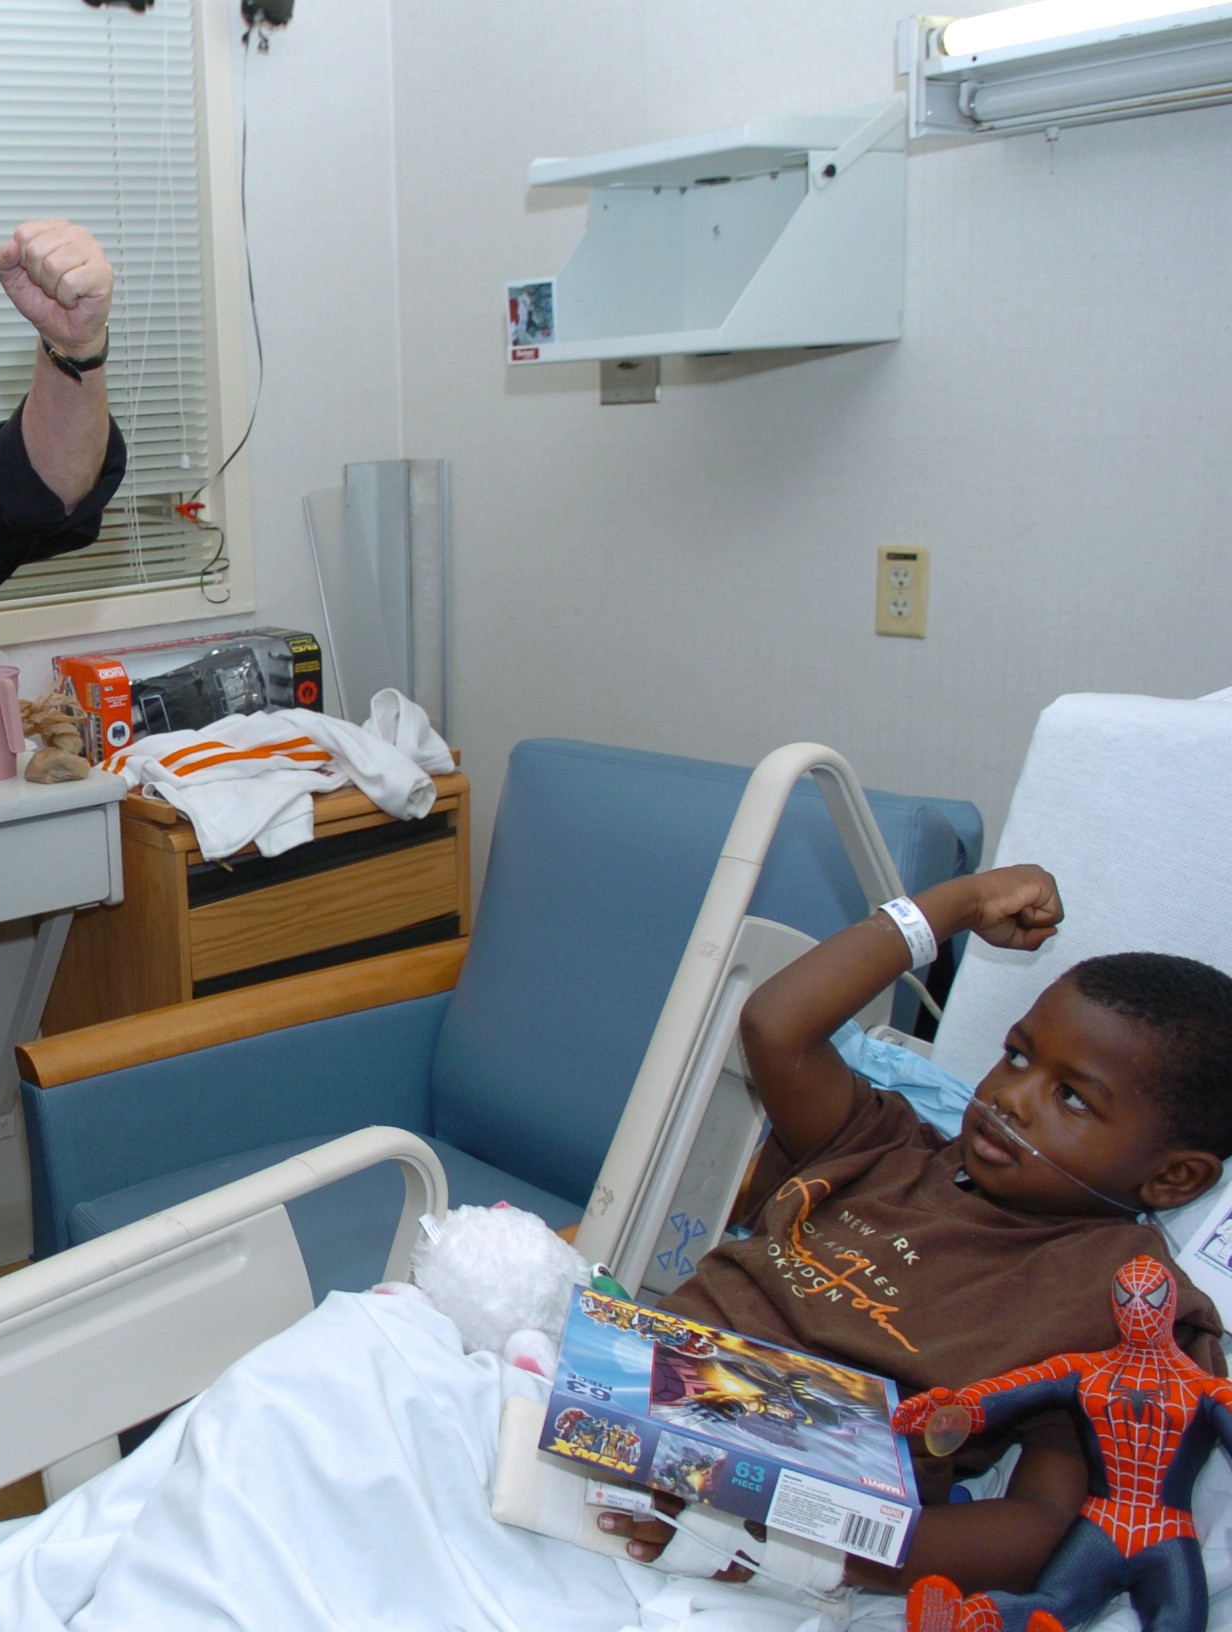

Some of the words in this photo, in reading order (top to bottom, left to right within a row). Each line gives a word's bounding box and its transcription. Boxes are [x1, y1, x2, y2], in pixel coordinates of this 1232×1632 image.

[838, 1210, 876, 1237] NEW
[768, 1235, 805, 1299] OKYO
[567, 1380, 611, 1402] 63
[735, 1460, 766, 1484] 63
[731, 1477, 763, 1493] PIECE
